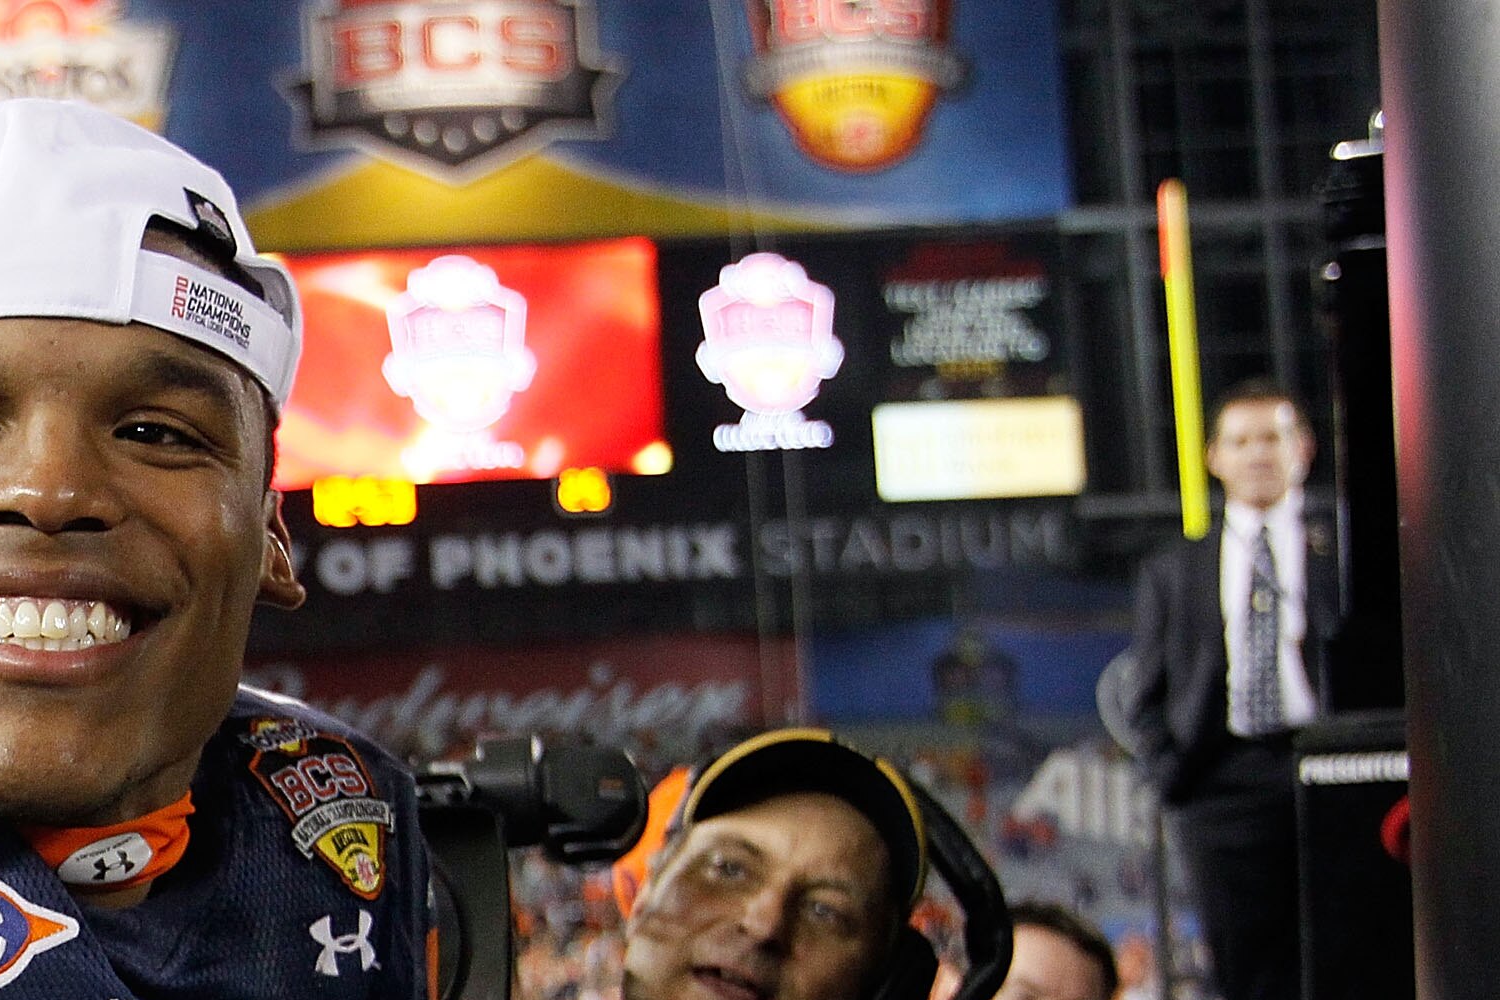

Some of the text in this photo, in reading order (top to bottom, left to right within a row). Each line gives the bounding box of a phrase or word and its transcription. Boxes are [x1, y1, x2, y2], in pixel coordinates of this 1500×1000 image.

[332, 14, 562, 88] BCS
[171, 275, 189, 319] 2010
[187, 297, 251, 339] CHAMPIONS
[189, 281, 244, 319] NATIONAL
[316, 534, 414, 596] OF
[429, 521, 740, 591] PHOENIX
[758, 509, 1069, 578] STADIUM
[270, 753, 368, 816] BCS
